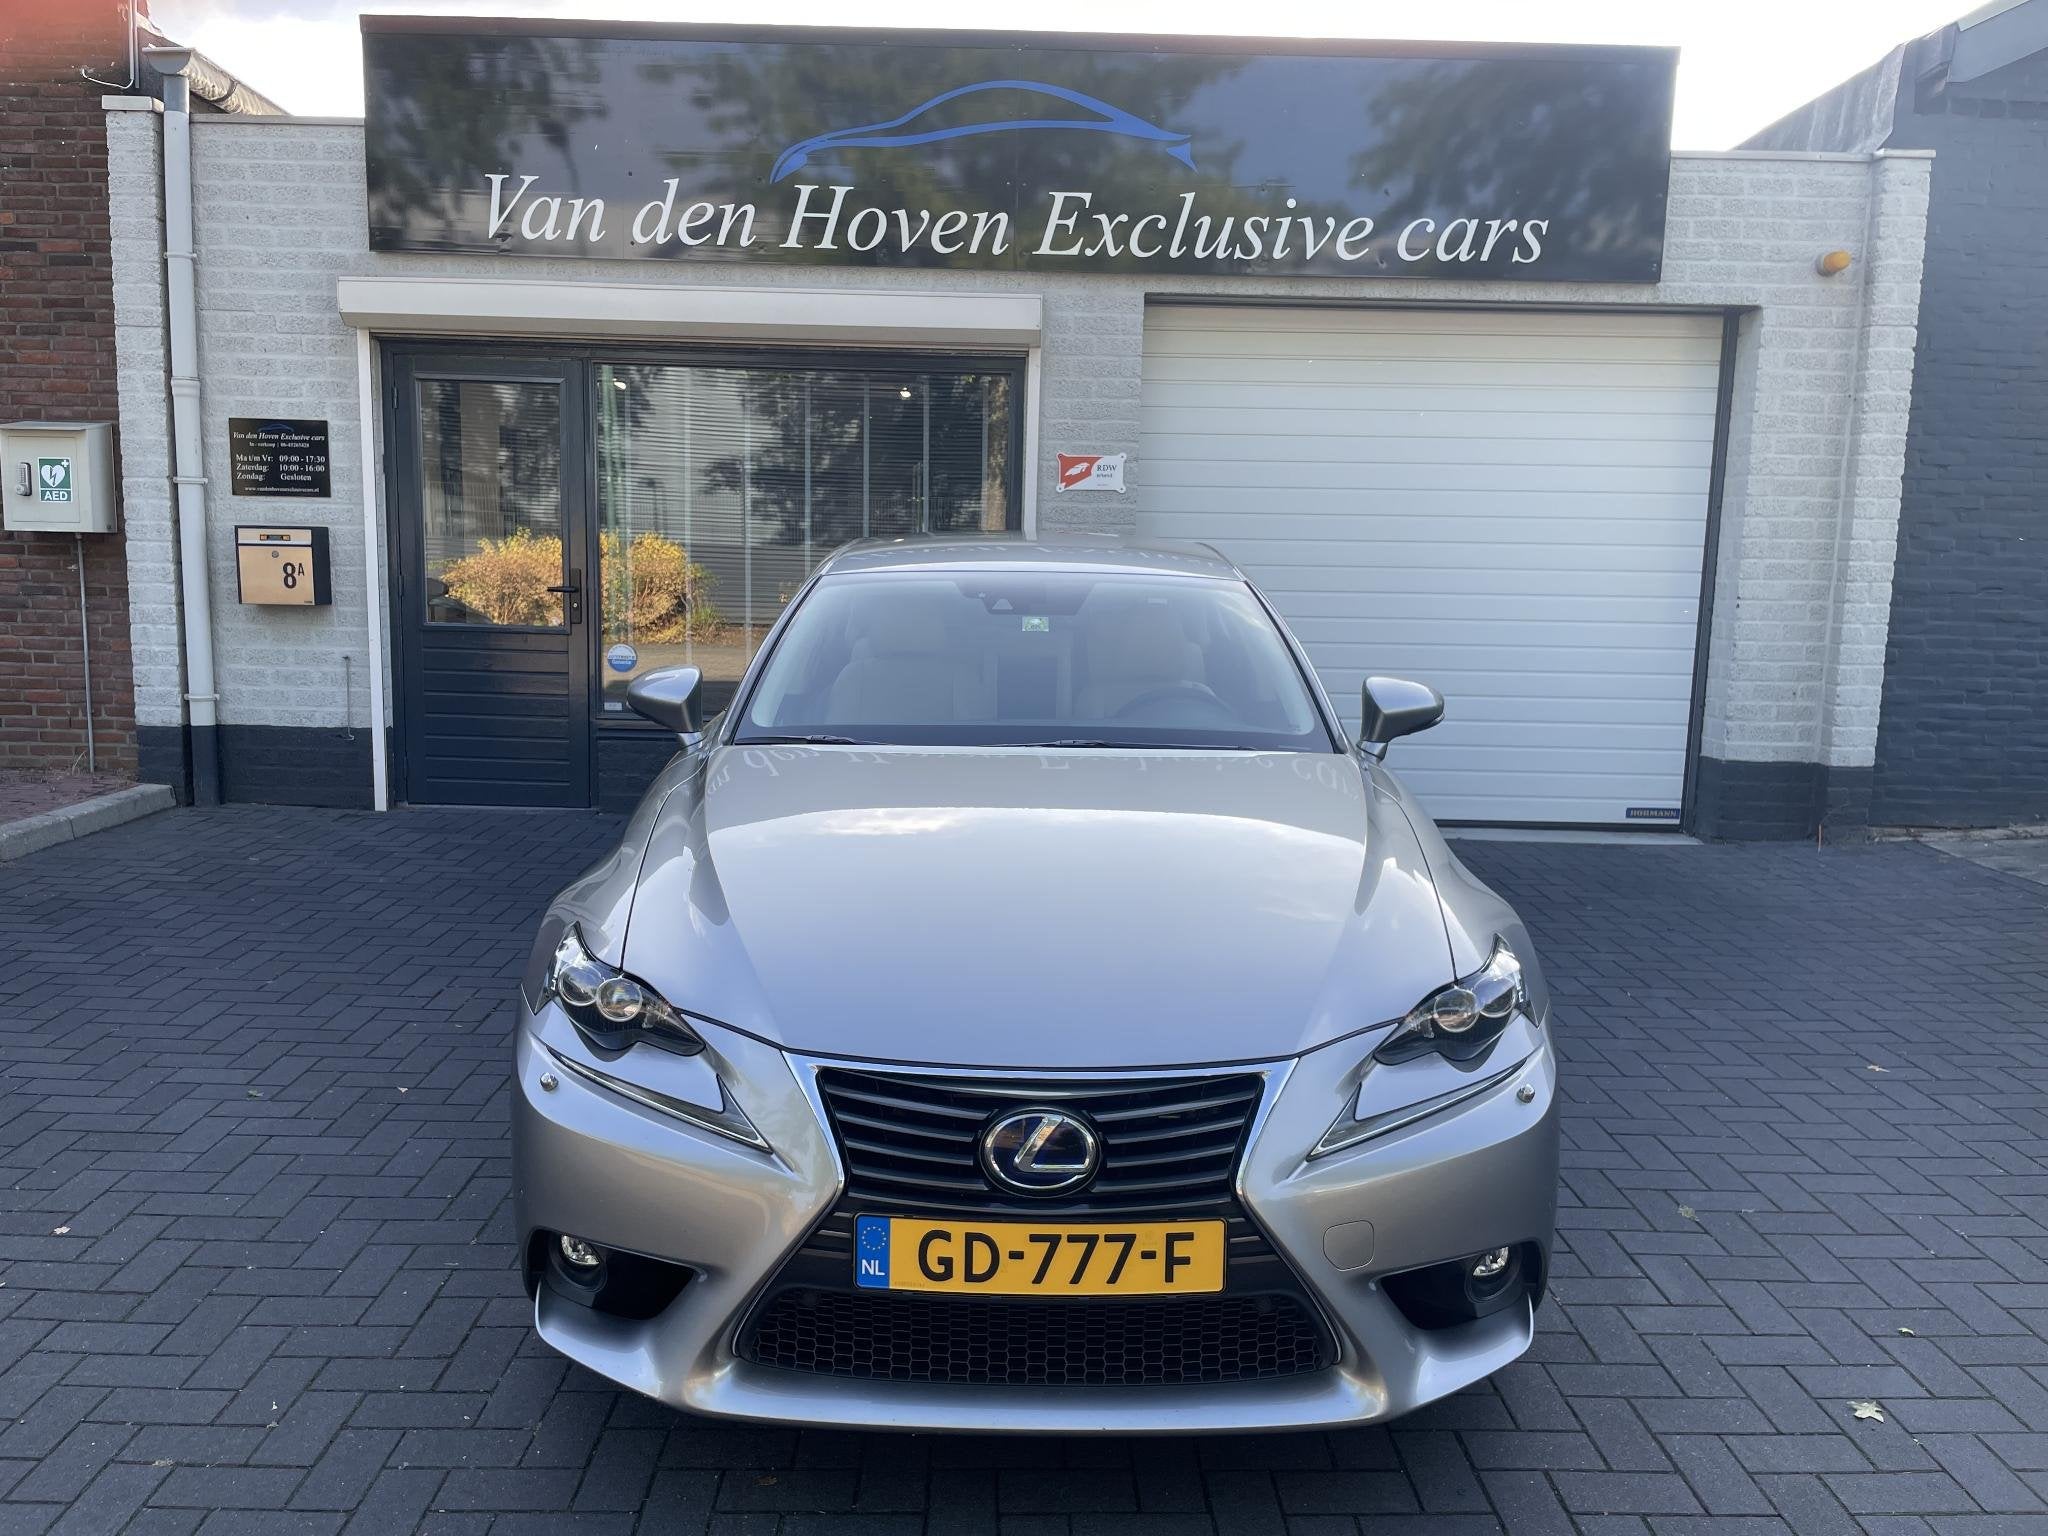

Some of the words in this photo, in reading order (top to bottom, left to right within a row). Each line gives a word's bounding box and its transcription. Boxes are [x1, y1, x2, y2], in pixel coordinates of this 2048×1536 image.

[485, 174, 606, 241] Van
[632, 178, 757, 247] den
[779, 184, 1009, 256] Hoven
[1032, 191, 1374, 262] Exclusive
[1397, 217, 1550, 264] cars
[258, 432, 279, 440] Hoven
[280, 433, 310, 441] Exclusive
[236, 454, 248, 462] Ma
[279, 455, 300, 463] 09:00
[236, 463, 270, 472] Zaterdag:
[279, 464, 299, 472] 10:00
[305, 464, 325, 472] 16:00
[1097, 464, 1118, 472] RDW
[236, 472, 266, 481] Zondag:
[280, 473, 312, 481] Gesloten
[44, 490, 68, 500] AED
[917, 1230, 1195, 1285] GD-777-F
[861, 1259, 886, 1276] NL
